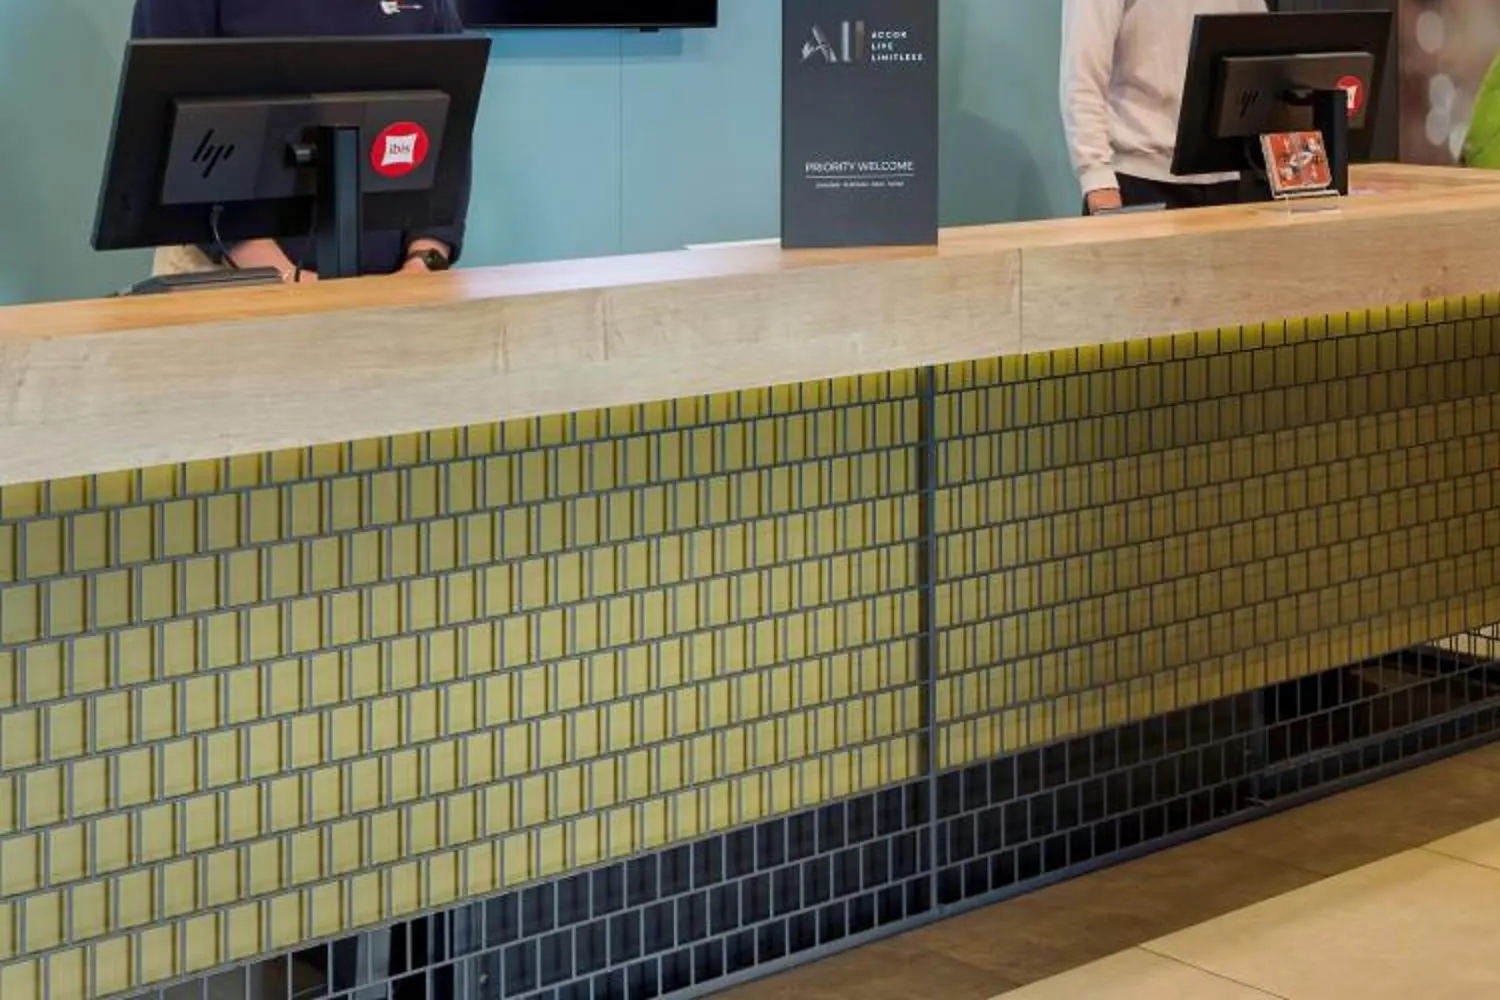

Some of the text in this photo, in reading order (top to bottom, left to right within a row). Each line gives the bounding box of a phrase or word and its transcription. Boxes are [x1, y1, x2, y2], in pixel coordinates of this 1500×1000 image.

[190, 128, 235, 180] hp
[389, 142, 411, 155] ibis
[805, 160, 914, 173] PRIORITY WELCOME
